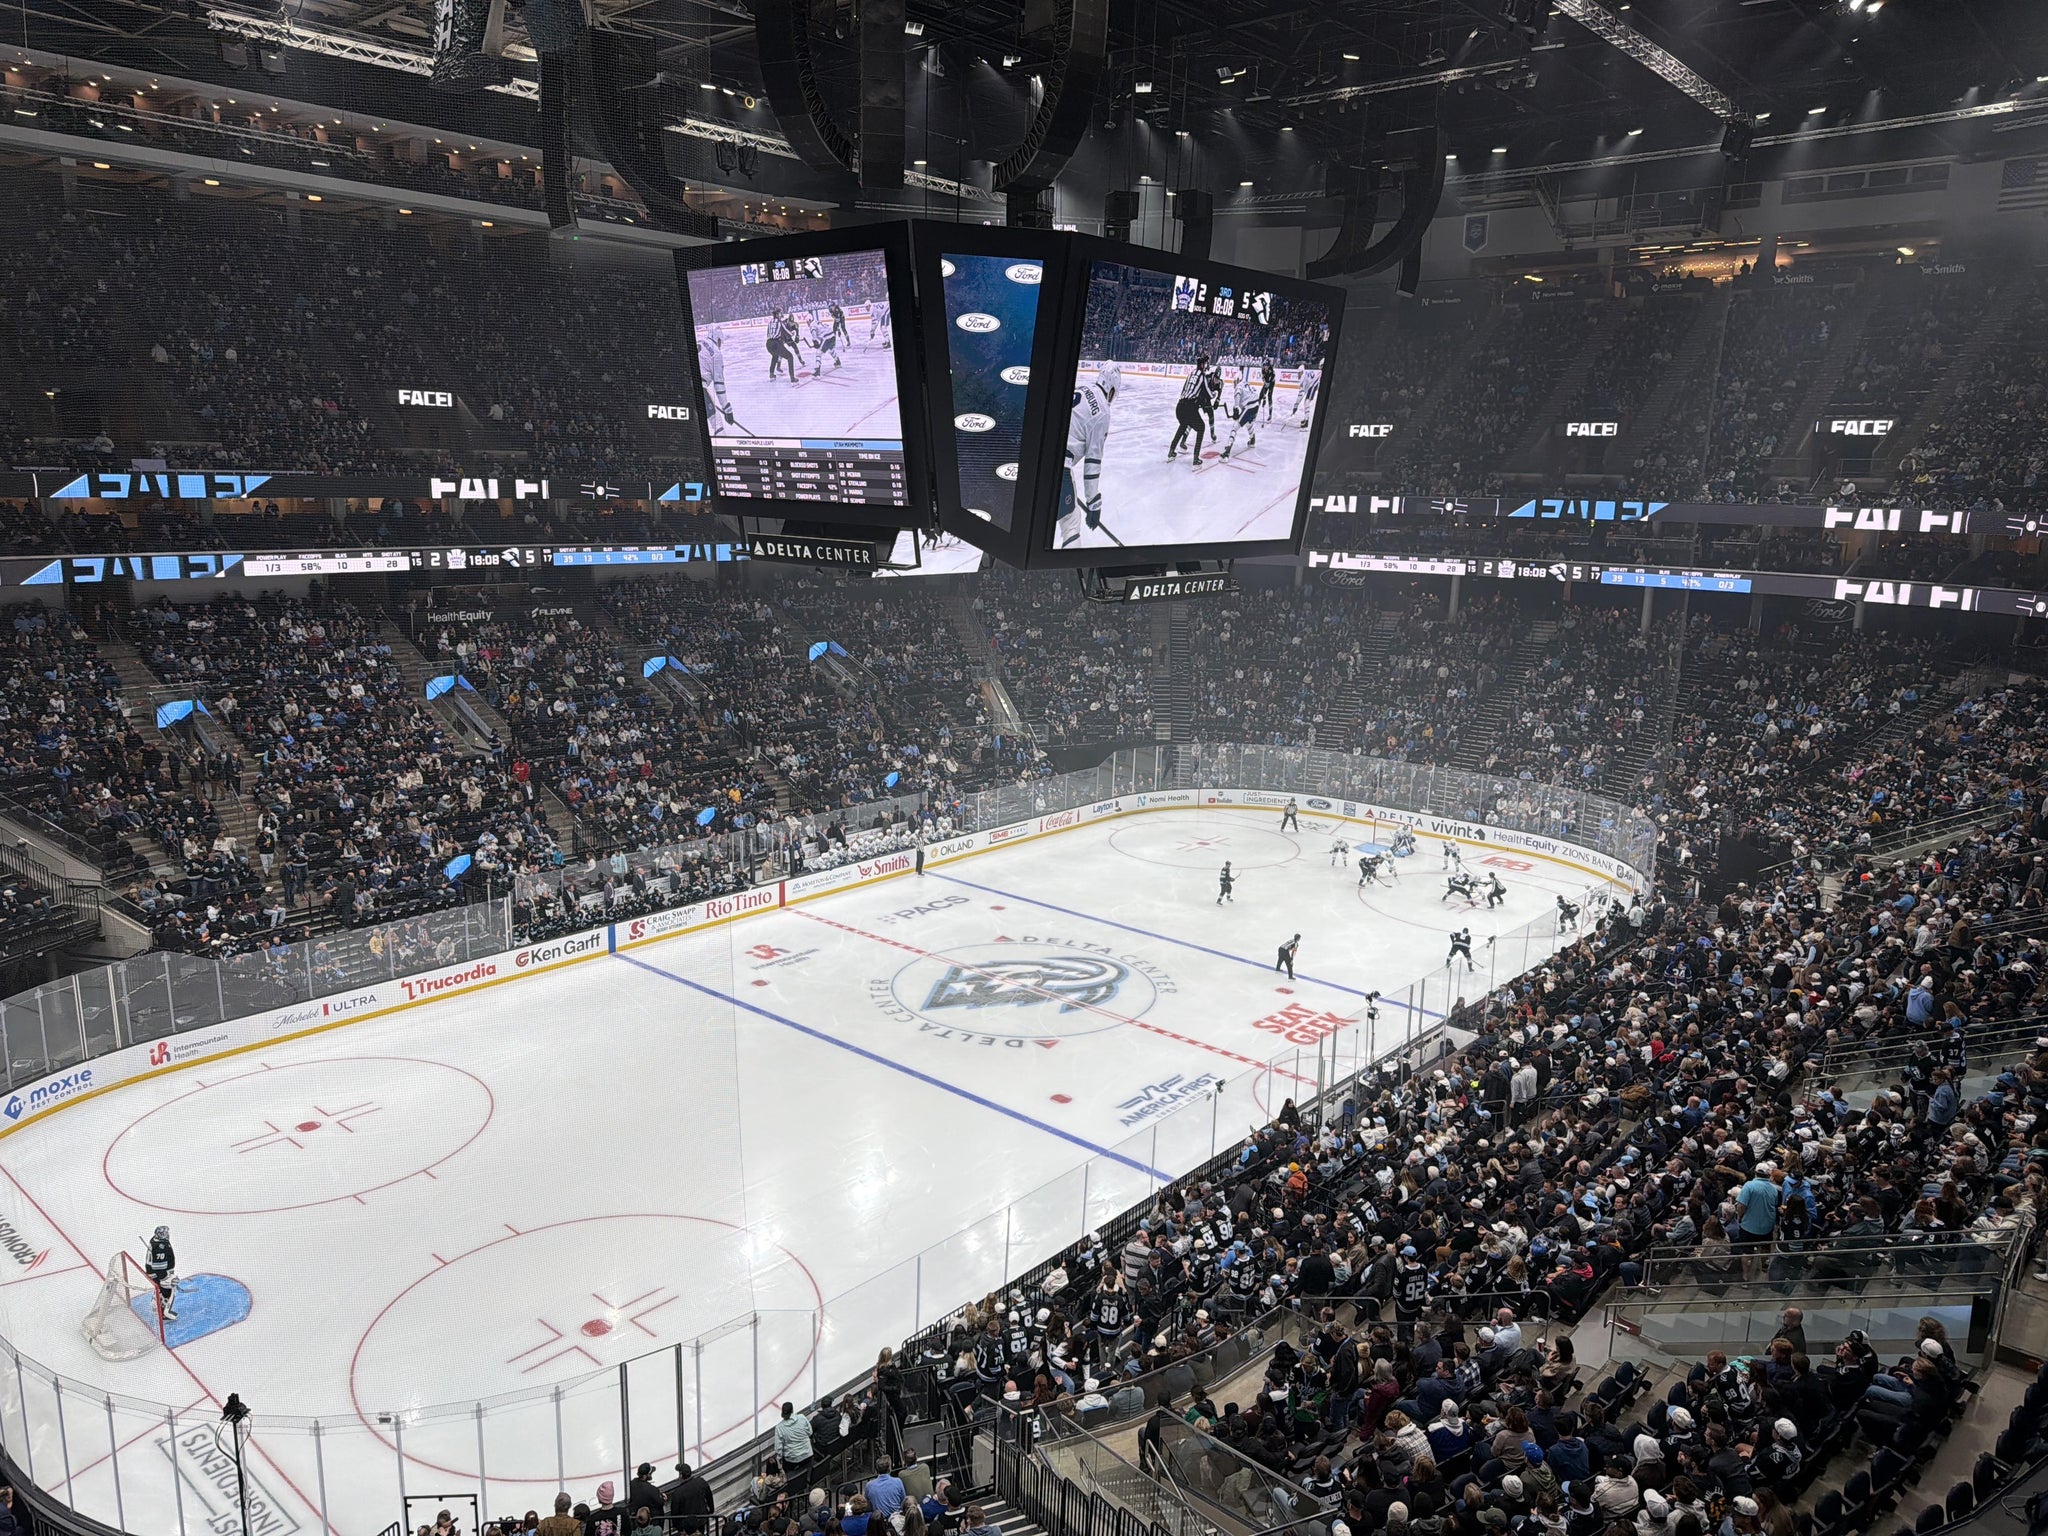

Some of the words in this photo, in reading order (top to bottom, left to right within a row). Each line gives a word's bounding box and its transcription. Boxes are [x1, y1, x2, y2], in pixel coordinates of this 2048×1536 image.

[760, 264, 766, 275] 2
[772, 268, 790, 280] 18:08
[796, 260, 802, 271] 5
[1014, 267, 1039, 281] Ford
[1198, 284, 1207, 301] 2
[1219, 286, 1233, 298] 3RD
[1242, 292, 1250, 309] 5
[1212, 297, 1234, 316] 18:08
[965, 316, 991, 329] Ford
[961, 417, 987, 429] Ford
[430, 552, 441, 566] 2
[469, 554, 500, 566] 18:08
[525, 550, 534, 563] 5
[543, 554, 552, 562] 17
[563, 555, 573, 563] 39
[651, 553, 663, 561] 0/3
[766, 542, 812, 559] DELTA
[816, 546, 871, 564] CENTER
[265, 564, 281, 572] 1/3
[301, 562, 321, 570] 58%
[337, 561, 347, 570] 10
[386, 560, 398, 568] 28
[411, 558, 422, 566] 15
[1467, 565, 1476, 573] 15
[1329, 569, 1366, 587] Ford
[1483, 562, 1492, 574] 2
[1518, 566, 1547, 578] 18:08
[1572, 567, 1582, 580] 5
[1591, 572, 1600, 580] 17
[1143, 583, 1180, 598] DELTA
[1184, 579, 1224, 594] CENTER
[1611, 574, 1623, 582] 39
[1635, 576, 1645, 584] 13
[1660, 577, 1667, 585] 5
[1718, 580, 1734, 590] 0/3
[427, 610, 493, 623] HealthEquity
[538, 607, 573, 616] FILEVINE
[1802, 599, 1847, 619] Ford
[1167, 793, 1190, 801] Health
[1310, 799, 1329, 809] Ford
[1092, 801, 1114, 815] Layton
[992, 830, 1009, 840] SME
[1431, 820, 1474, 838] vivint
[940, 839, 974, 856] OKLAND
[1493, 830, 1558, 854] HealthEquity
[874, 855, 910, 876] Smith's
[1562, 847, 1590, 862] ZIONS
[1592, 856, 1614, 873] BANK
[705, 901, 732, 920] Rio
[734, 890, 773, 910] Tinto
[895, 895, 970, 919] PACS
[647, 913, 670, 925] CRAIG
[672, 906, 696, 918] SWAPP
[531, 945, 561, 965] Ken
[563, 933, 601, 956] Garff
[1022, 936, 1113, 954] DELTA
[1119, 953, 1178, 995] CENTER
[416, 962, 497, 995] Trucordia
[333, 994, 377, 1013] ULTRA
[870, 976, 916, 1023] CENTER
[1252, 1002, 1319, 1034] SEAT
[919, 1022, 1024, 1049] DELTA
[1284, 1011, 1360, 1045] GEEK
[173, 1034, 229, 1053] Intermountain
[174, 1048, 200, 1061] Health
[1949, 1049, 1959, 1057] 37
[29, 1069, 93, 1104] moxie
[31, 1099, 50, 1111] PEST
[54, 1081, 94, 1101] CONTROL
[1119, 1093, 1184, 1127] AMERICA
[1178, 1072, 1218, 1095] FIRST
[0, 1214, 36, 1266] CROWDS
[1793, 1229, 1800, 1238] 9
[1928, 1234, 1935, 1242] 9
[1405, 1281, 1425, 1301] 92
[1100, 1305, 1119, 1325] 98
